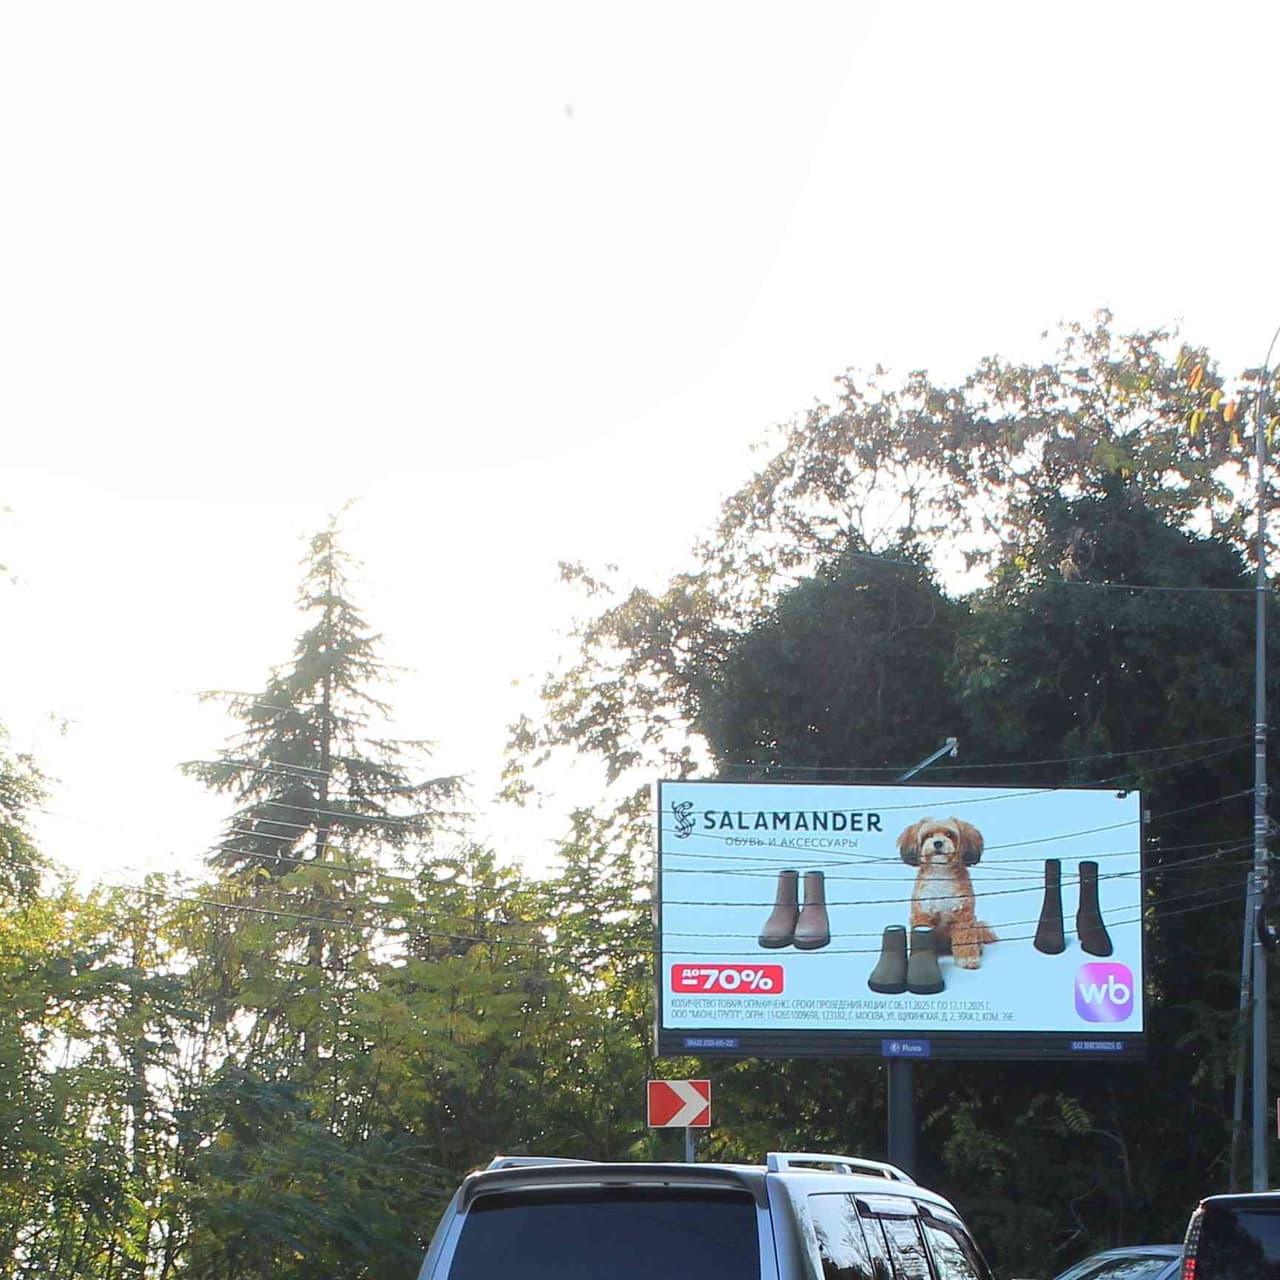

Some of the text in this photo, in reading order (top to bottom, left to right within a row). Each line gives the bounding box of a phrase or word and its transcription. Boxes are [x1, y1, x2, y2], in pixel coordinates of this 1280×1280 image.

[703, 809, 883, 832] SALAMANDER
[725, 836, 764, 847] ОБУВЬ
[780, 837, 858, 848] АКСЕССУАРЫ
[1078, 974, 1131, 1006] wb
